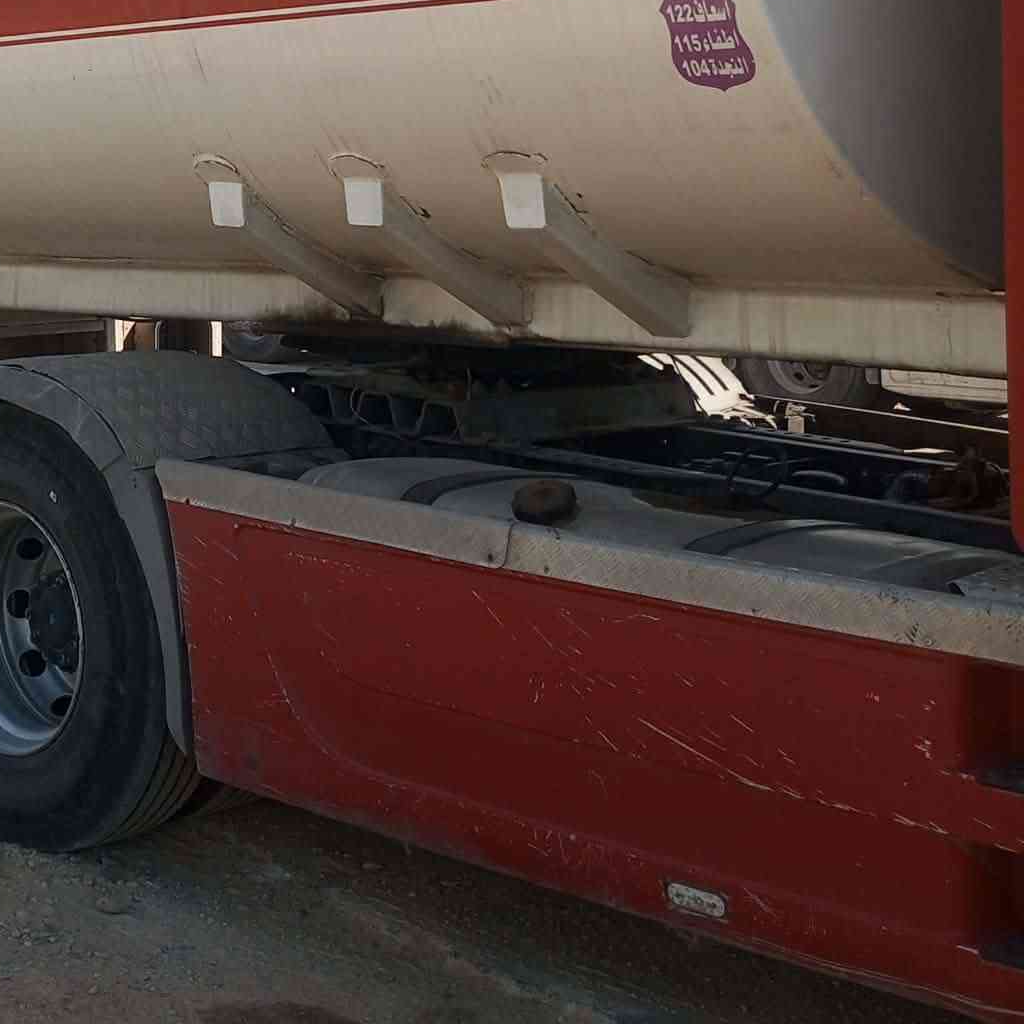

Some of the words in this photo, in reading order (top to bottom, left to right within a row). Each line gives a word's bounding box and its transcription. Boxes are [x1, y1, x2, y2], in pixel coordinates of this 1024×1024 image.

[666, 3, 694, 23] 122
[674, 34, 702, 53] 115
[682, 59, 712, 77] 104
